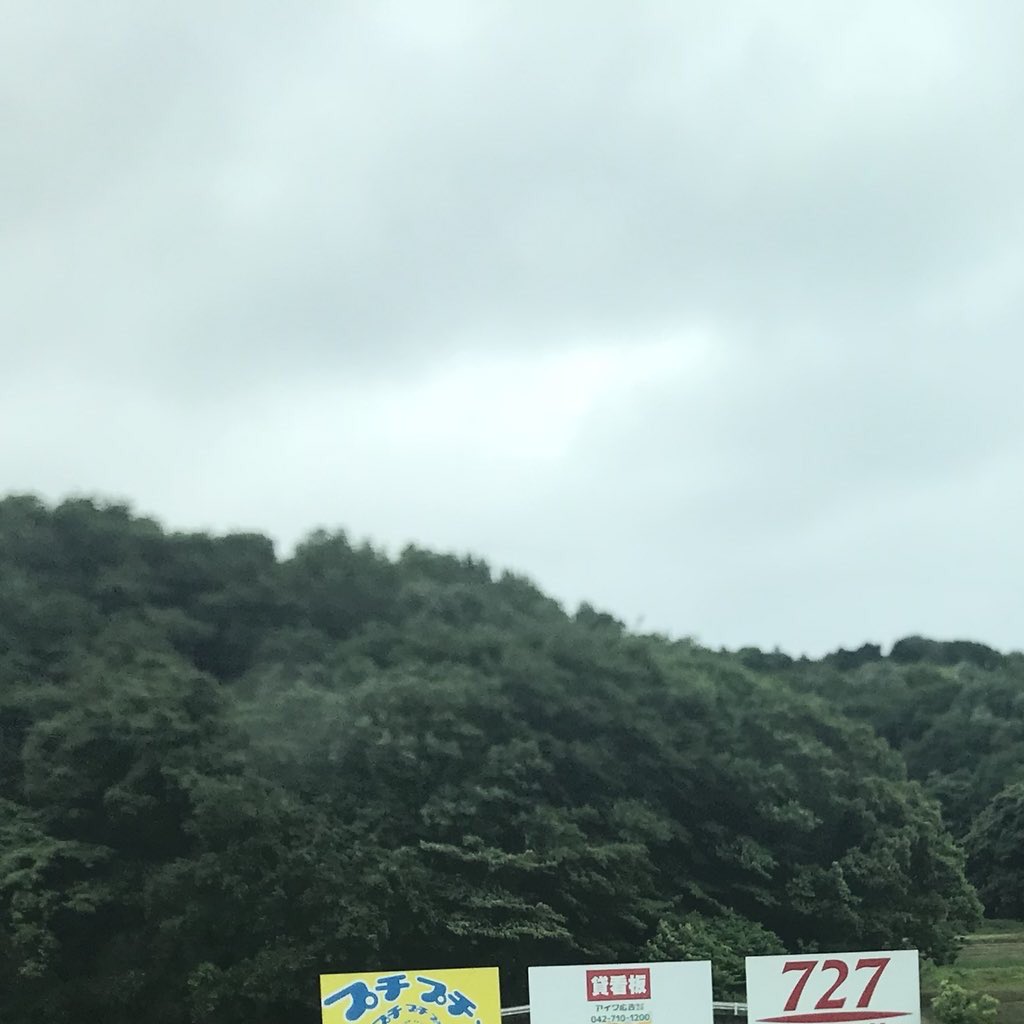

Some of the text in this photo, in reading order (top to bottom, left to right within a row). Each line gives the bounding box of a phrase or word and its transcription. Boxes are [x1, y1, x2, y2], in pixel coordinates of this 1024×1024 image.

[591, 975, 647, 996] 貸看板
[782, 958, 891, 1011] 727
[591, 1014, 650, 1023] 042-710-1200
